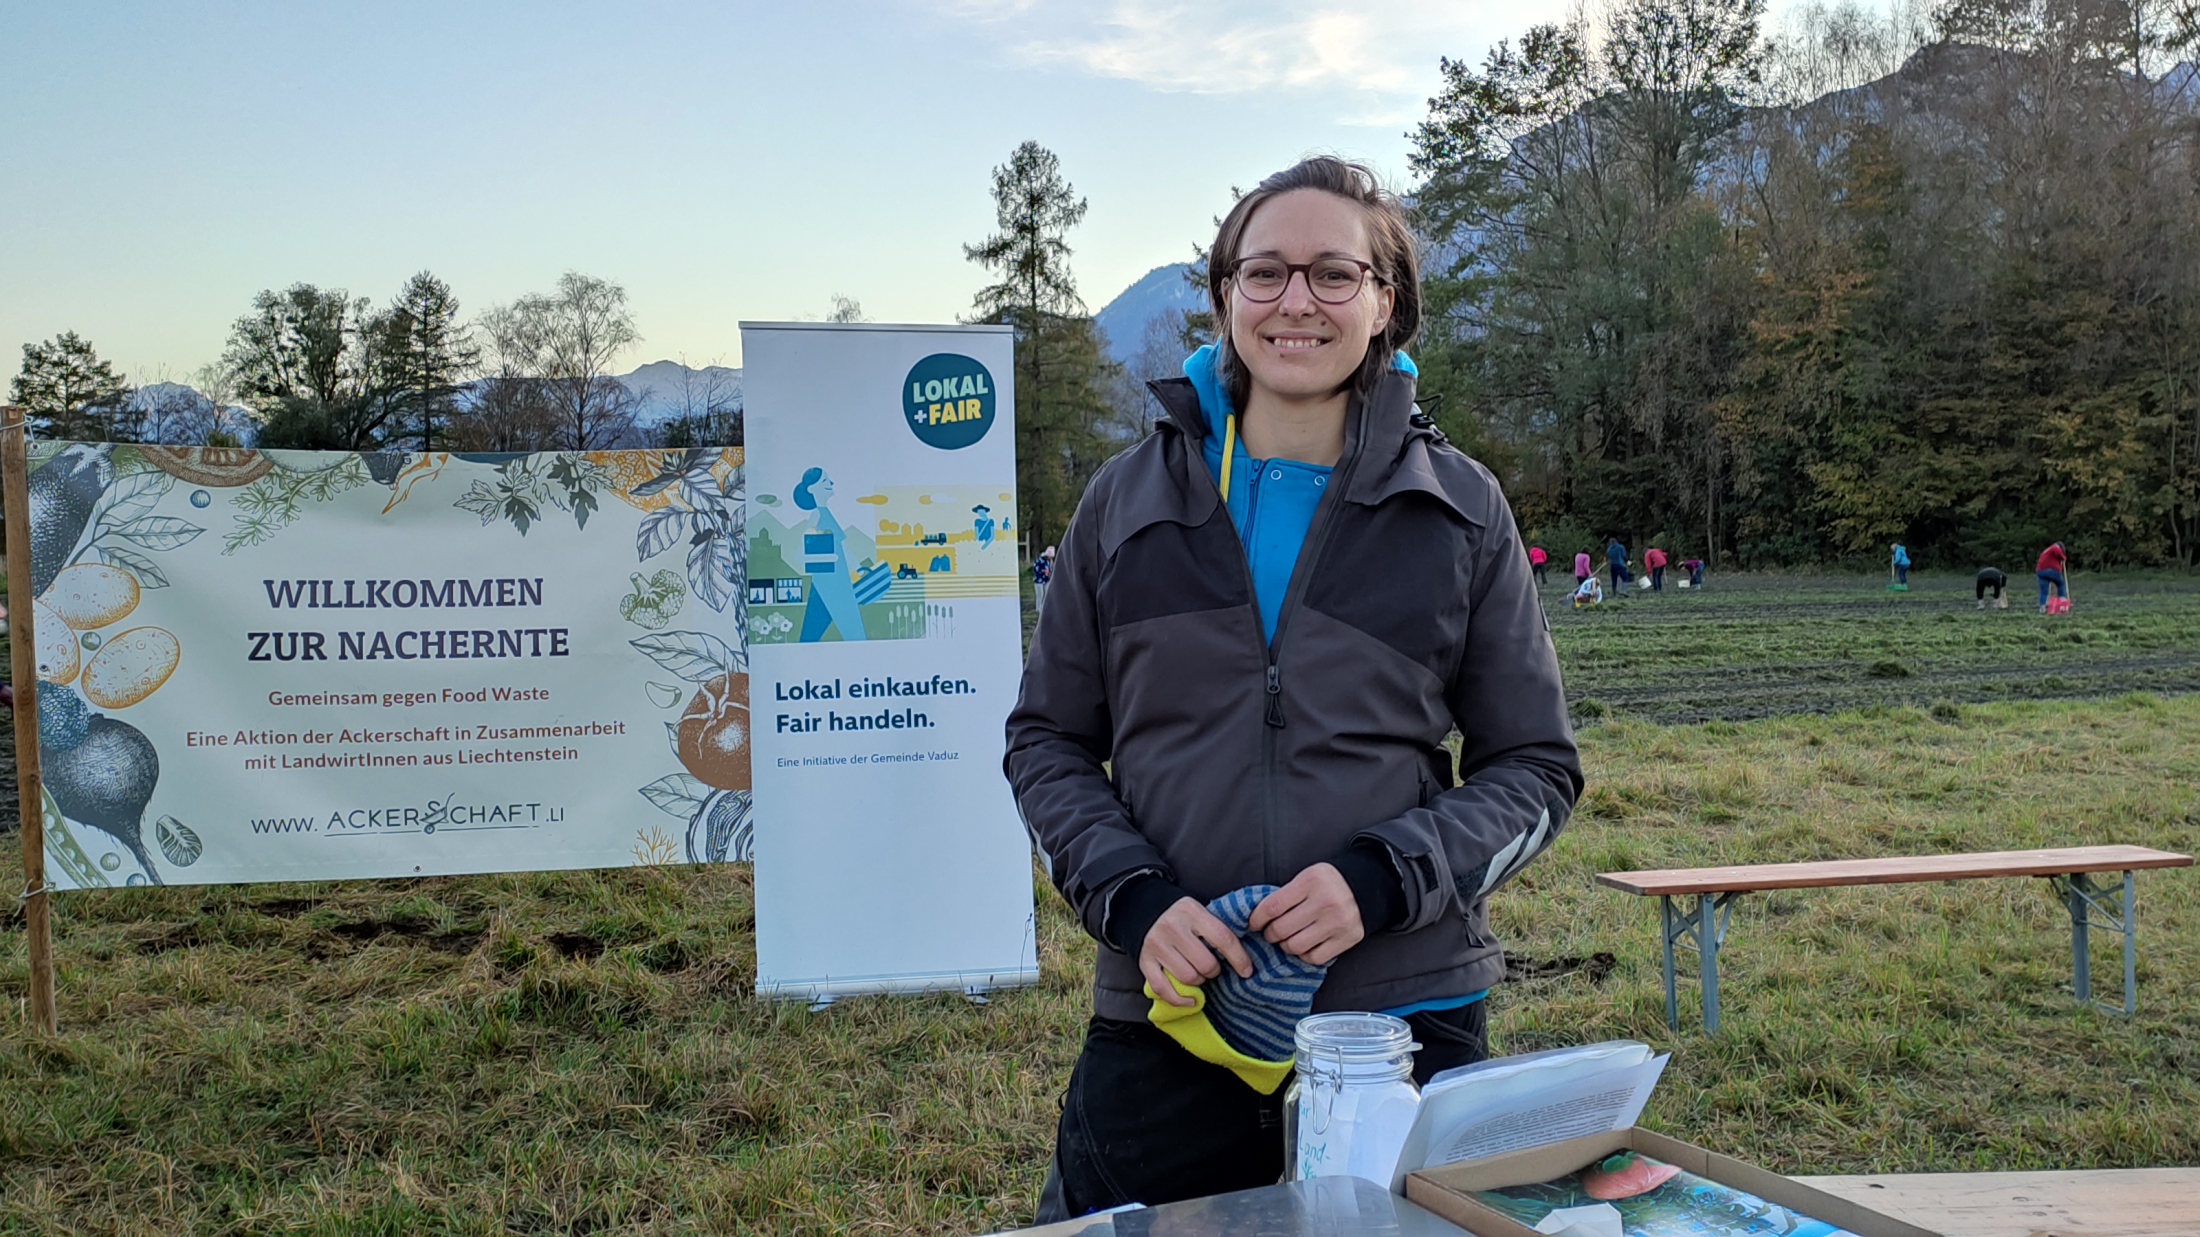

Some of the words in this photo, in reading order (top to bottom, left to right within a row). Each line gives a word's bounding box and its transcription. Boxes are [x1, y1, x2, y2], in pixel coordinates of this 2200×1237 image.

[913, 373, 988, 403] LOKAL
[262, 577, 544, 609] WILLKOMMEN
[247, 631, 328, 662] ZUR
[337, 628, 570, 661] NACHERNTE
[268, 690, 378, 706] Gemeinsam
[382, 692, 437, 708] gegen
[442, 687, 487, 703] Food
[491, 686, 550, 702] Waste
[775, 678, 841, 702] Lokal
[848, 674, 977, 699] einkaufen.
[186, 731, 228, 747] Eine
[233, 729, 298, 746] Aktion
[302, 729, 334, 744] der
[338, 726, 450, 744] Ackerschaft
[455, 725, 471, 741] in
[476, 720, 626, 740] Zusammenarbeit
[776, 711, 822, 734] Fair
[829, 707, 935, 732] handeln.
[245, 754, 277, 770] mit
[282, 752, 418, 769] LandwirtInnen
[422, 753, 453, 766] aus
[458, 745, 578, 765] Liechtenstein
[777, 757, 800, 768] Eine
[802, 755, 847, 767] Initiative
[849, 753, 868, 765] der
[870, 751, 925, 764] Gemeinde
[927, 750, 959, 761] Vaduz
